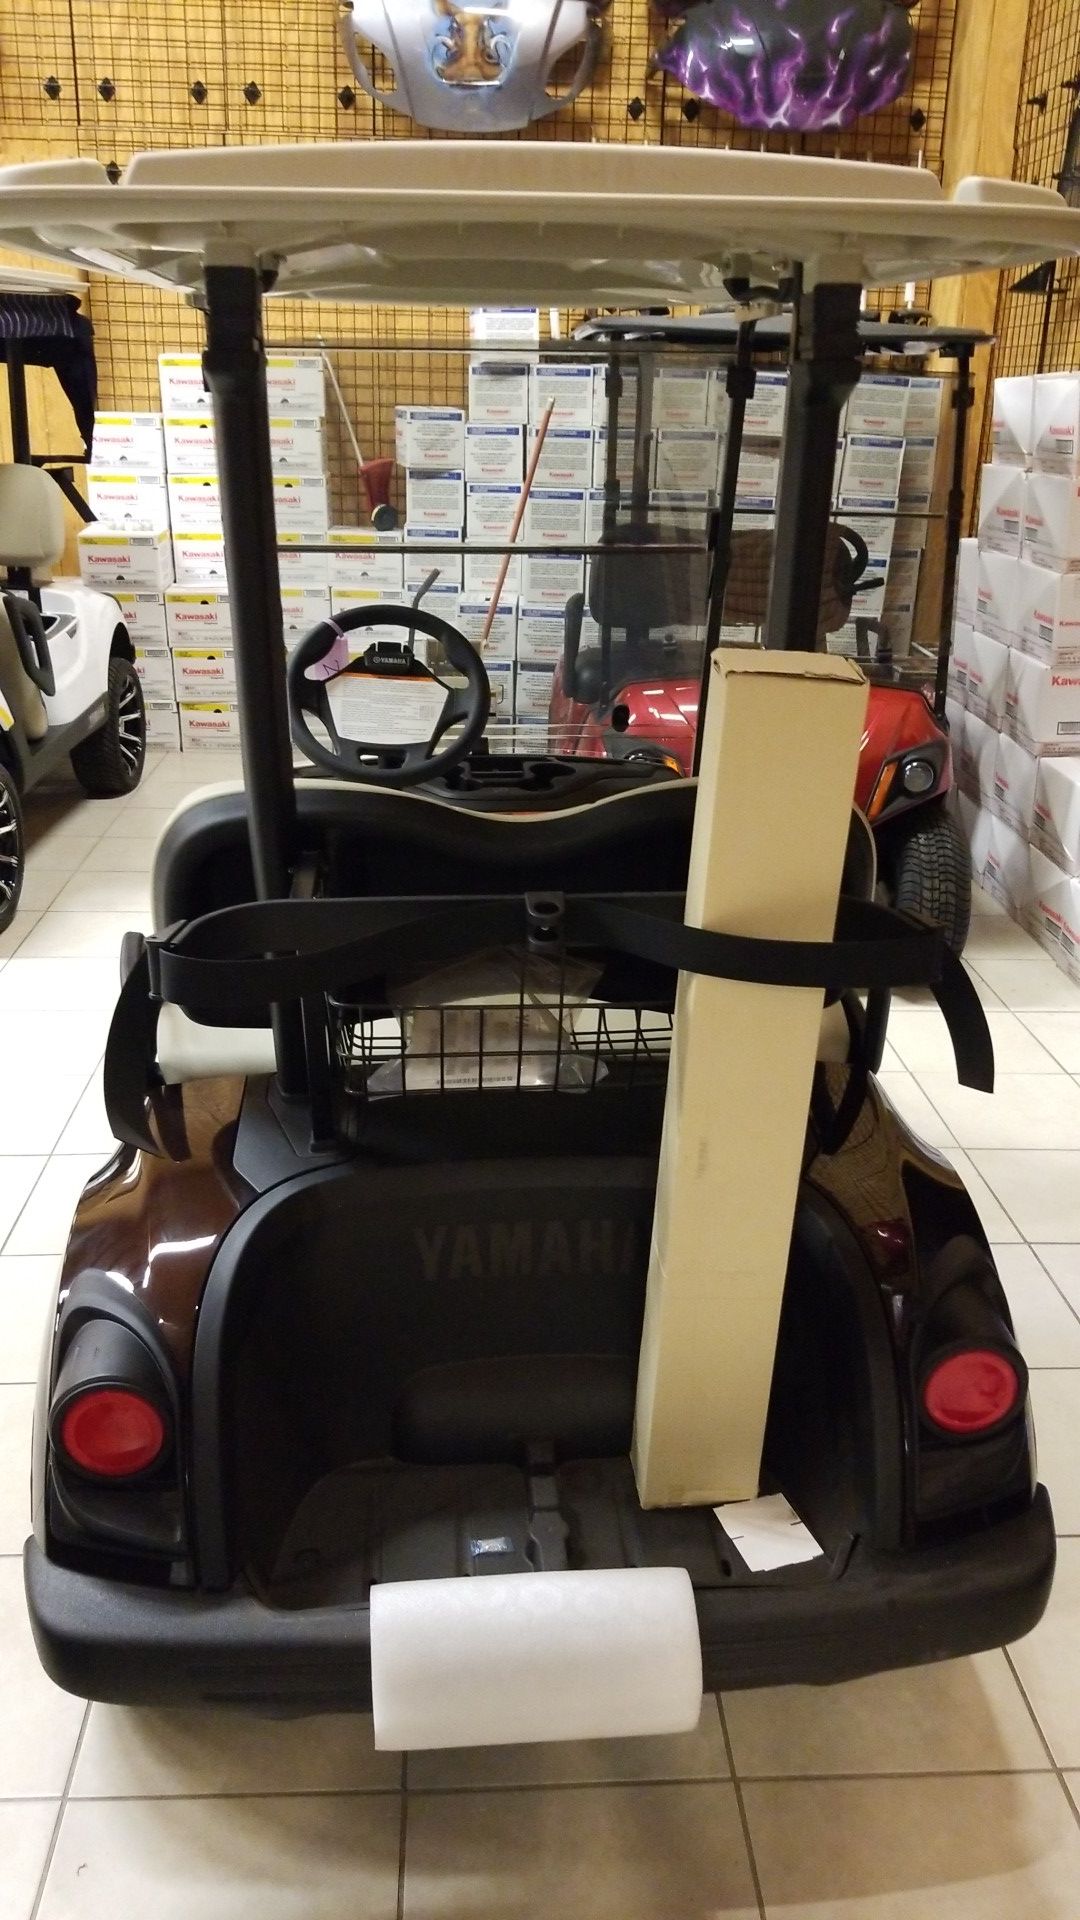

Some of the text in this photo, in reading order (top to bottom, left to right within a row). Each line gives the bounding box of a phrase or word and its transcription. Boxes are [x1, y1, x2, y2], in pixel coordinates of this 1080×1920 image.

[169, 378, 203, 386] Kawasa
[88, 555, 131, 563] Kawasaki
[175, 612, 218, 620] Kawasaki
[380, 657, 407, 665] YAMAHA
[182, 667, 224, 675] Kawasaki
[188, 719, 231, 728] Kawasaki
